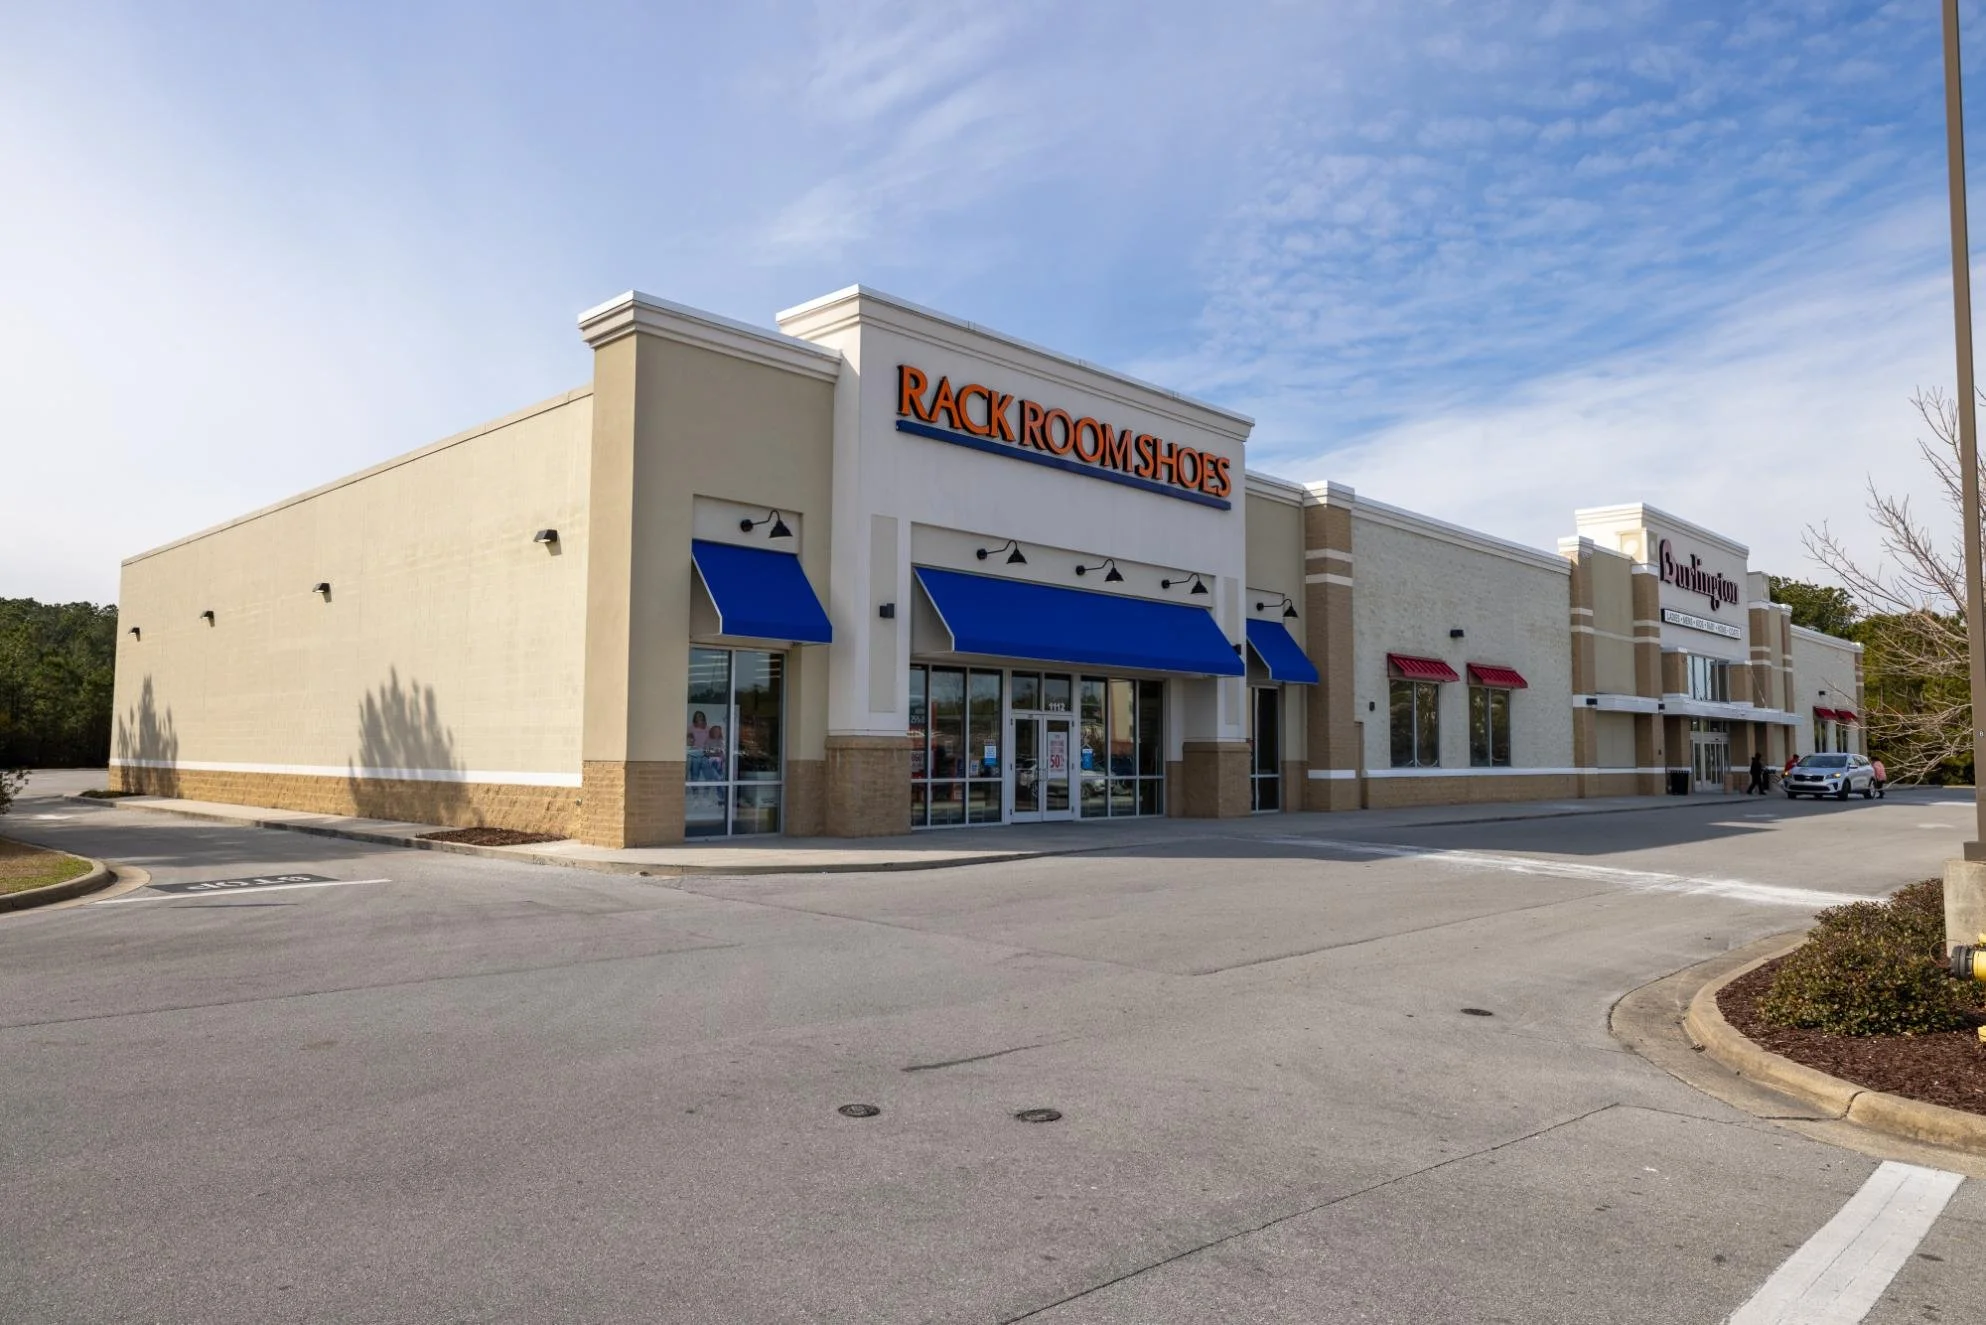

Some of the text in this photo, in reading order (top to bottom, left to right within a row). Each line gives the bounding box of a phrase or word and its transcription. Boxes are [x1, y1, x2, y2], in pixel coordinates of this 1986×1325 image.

[896, 364, 1232, 498] RACK ROOM SHOES
[1660, 539, 1739, 611] Burlington
[187, 876, 311, 890] STOP
